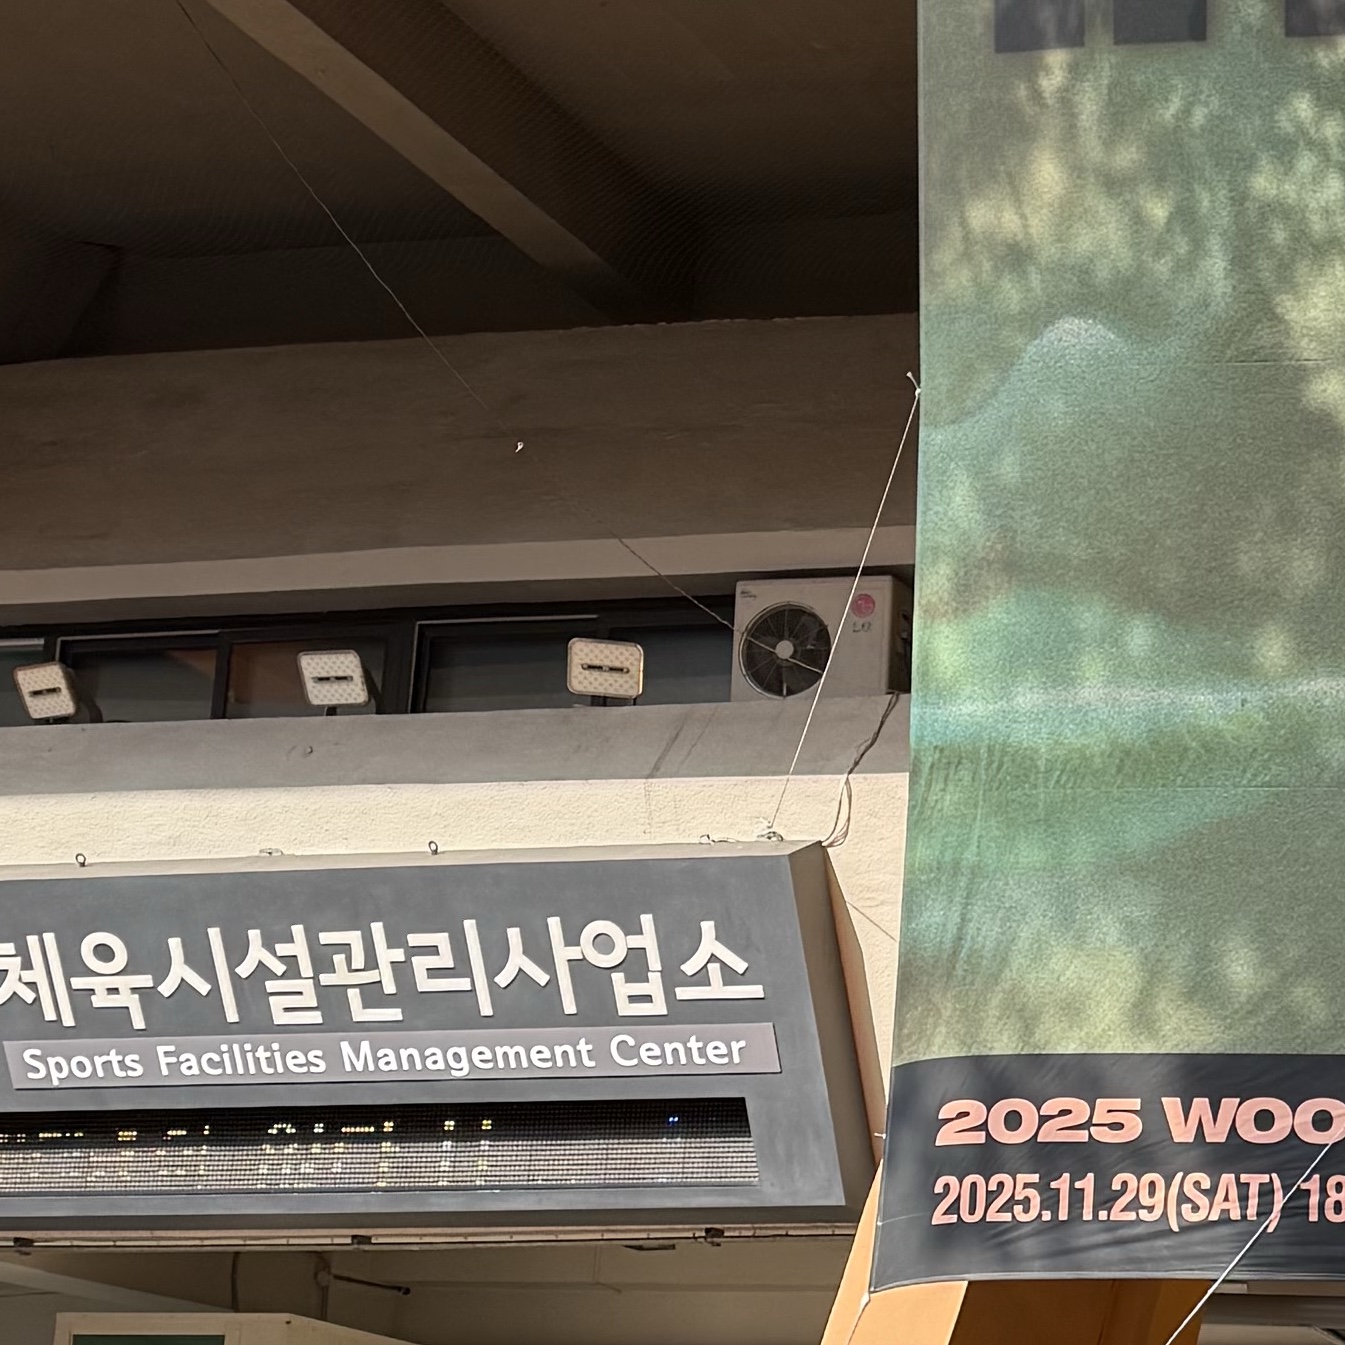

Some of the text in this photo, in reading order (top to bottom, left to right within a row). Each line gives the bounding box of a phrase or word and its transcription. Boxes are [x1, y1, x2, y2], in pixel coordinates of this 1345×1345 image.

[22, 1033, 747, 1085] Sports Facilities Management Center
[935, 1096, 1143, 1146] 2025
[931, 1172, 1285, 1234] 2025.11.29(SAT)
